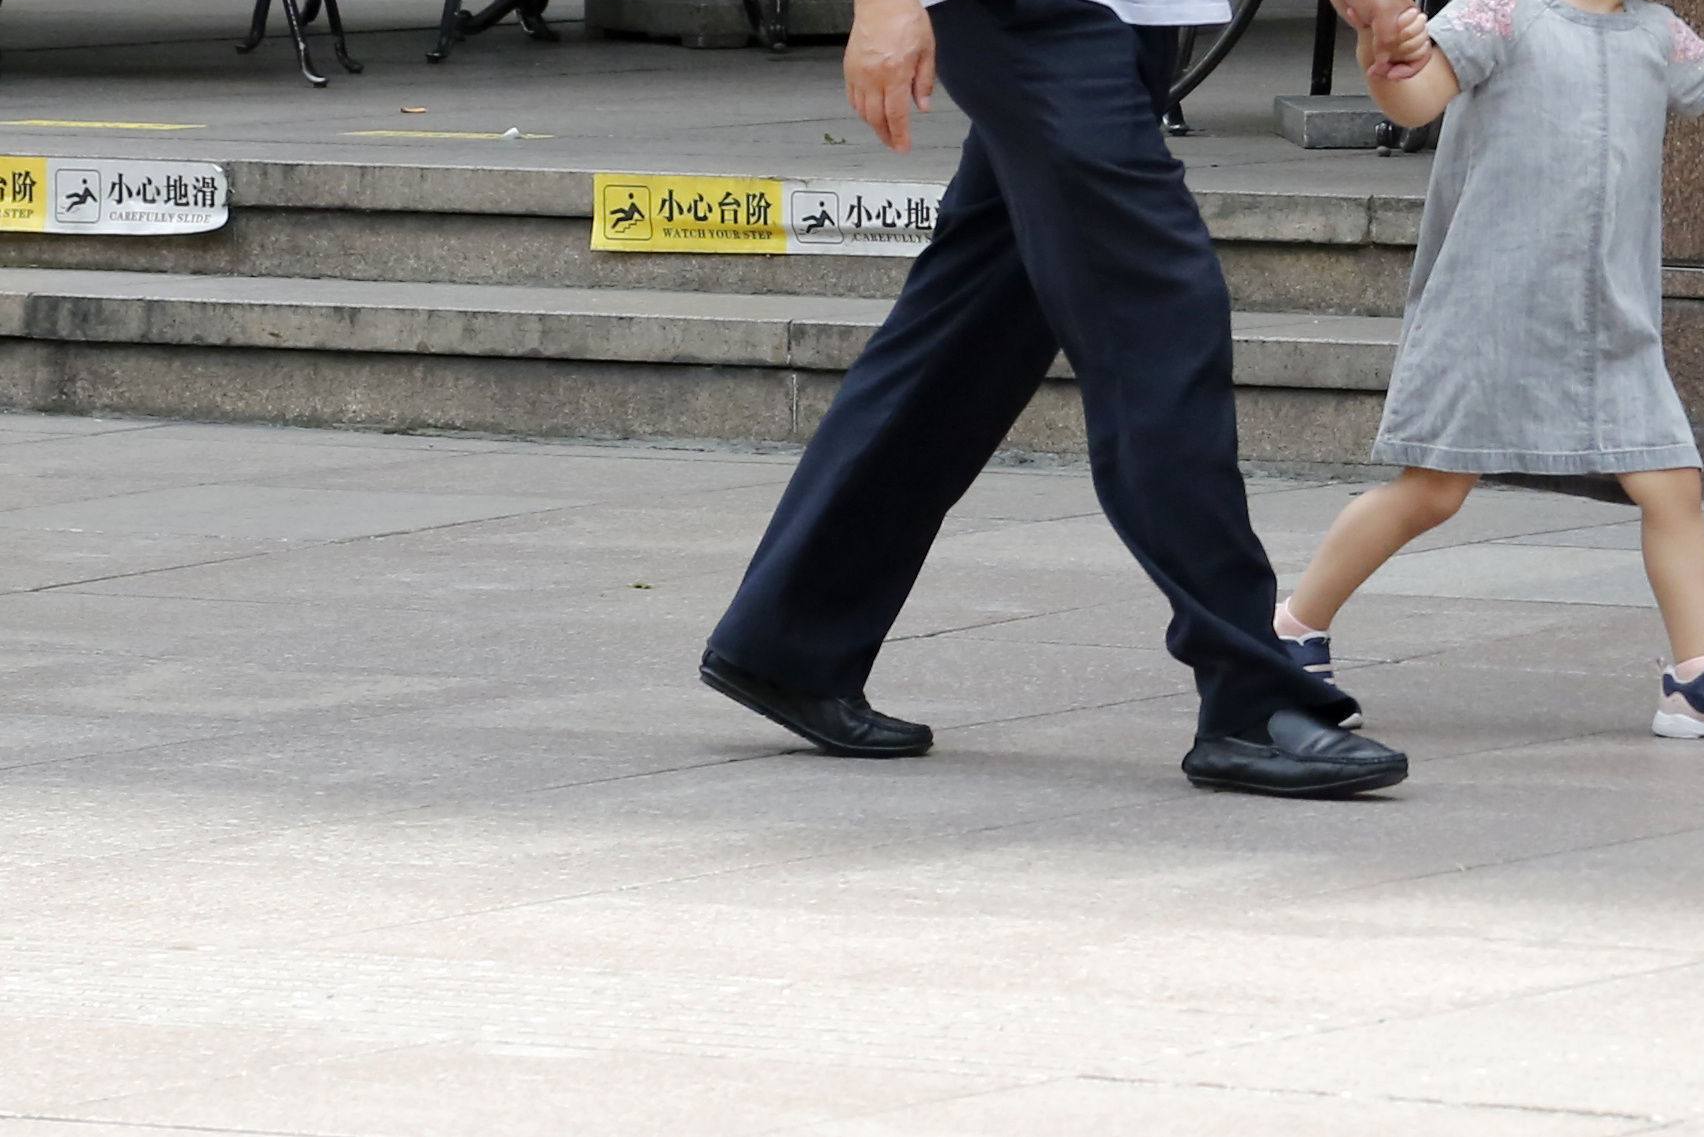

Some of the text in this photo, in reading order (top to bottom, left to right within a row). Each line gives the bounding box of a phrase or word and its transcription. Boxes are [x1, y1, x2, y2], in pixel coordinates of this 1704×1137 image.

[108, 173, 218, 208] 小心地滑
[657, 189, 772, 225] 小心台阶
[846, 195, 941, 230] 小心地
[3, 209, 34, 219] STEP
[109, 211, 212, 223] CAREFULLY SLIDE
[663, 227, 773, 240] WATCH YOUR STEP
[853, 232, 921, 243] CAREFULLY
